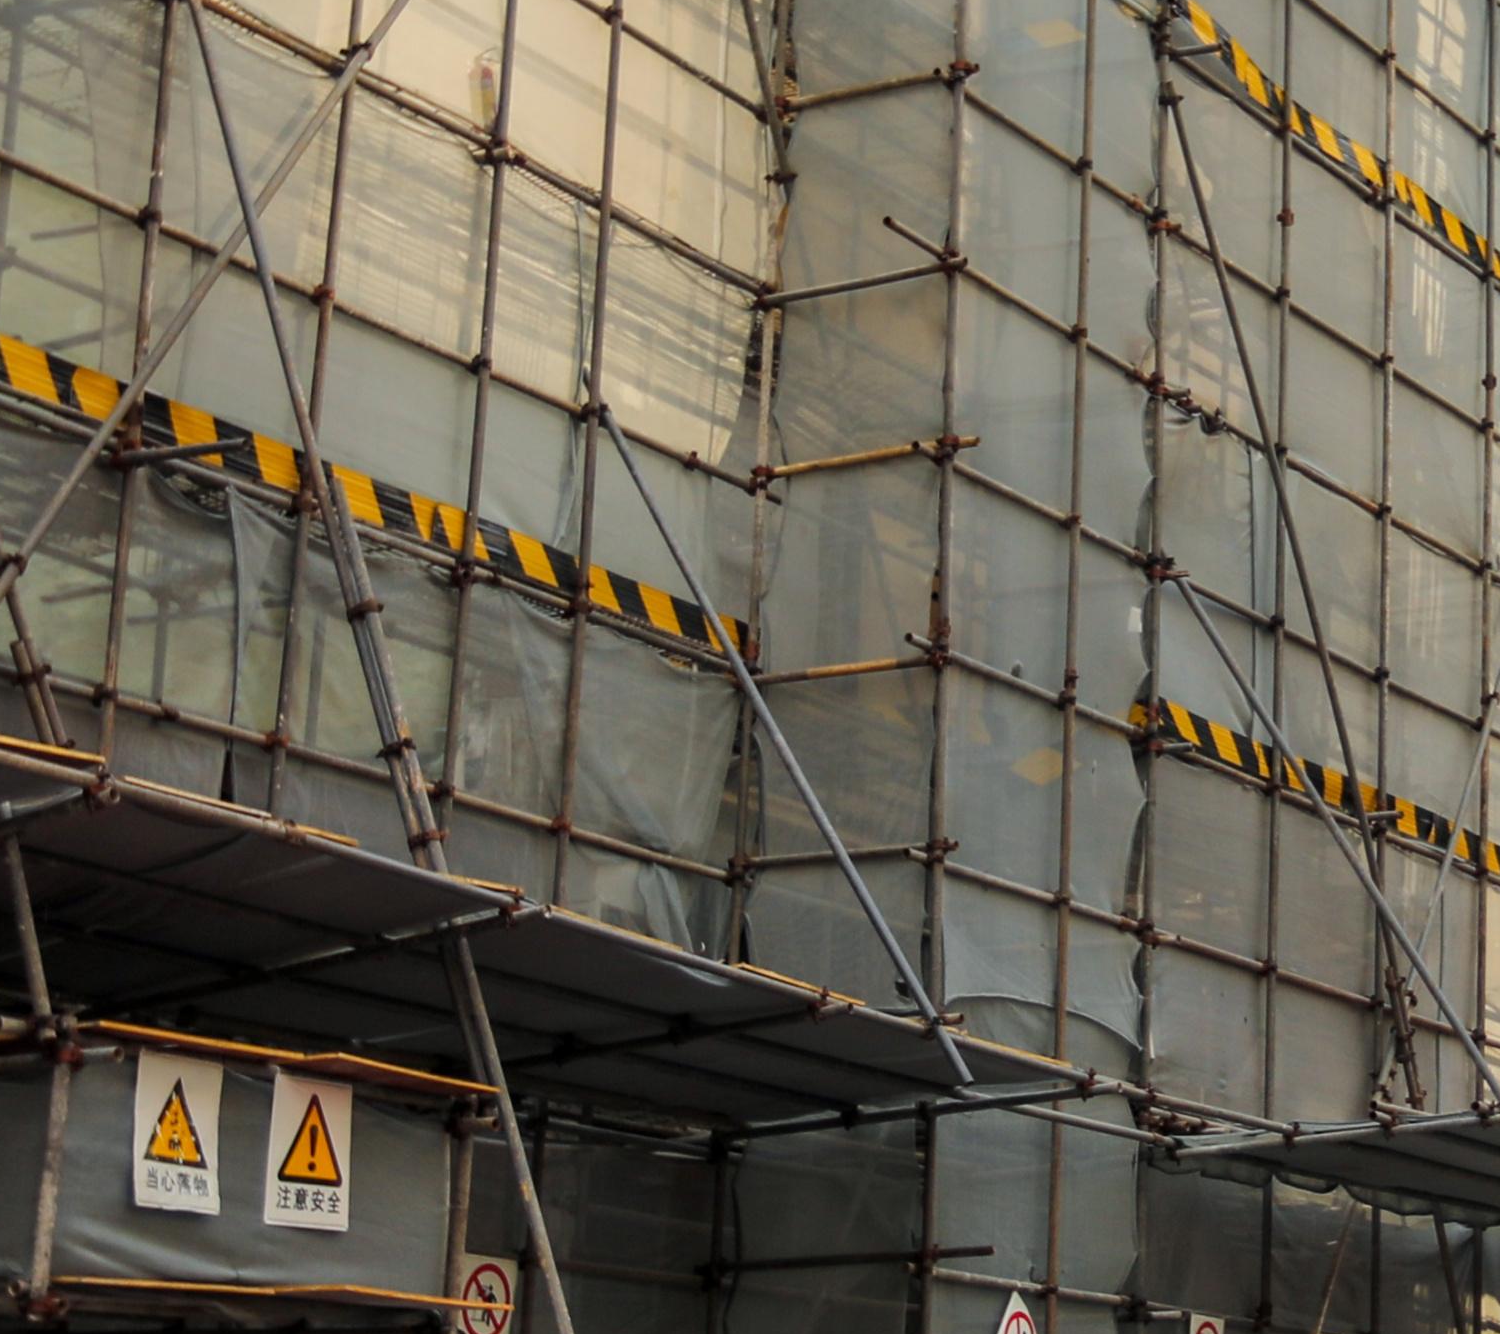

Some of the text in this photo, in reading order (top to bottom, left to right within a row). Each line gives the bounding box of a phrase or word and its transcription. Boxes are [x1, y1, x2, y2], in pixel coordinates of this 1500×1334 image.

[146, 1167, 209, 1197] 当心落物
[276, 1185, 341, 1215] 注意安全
